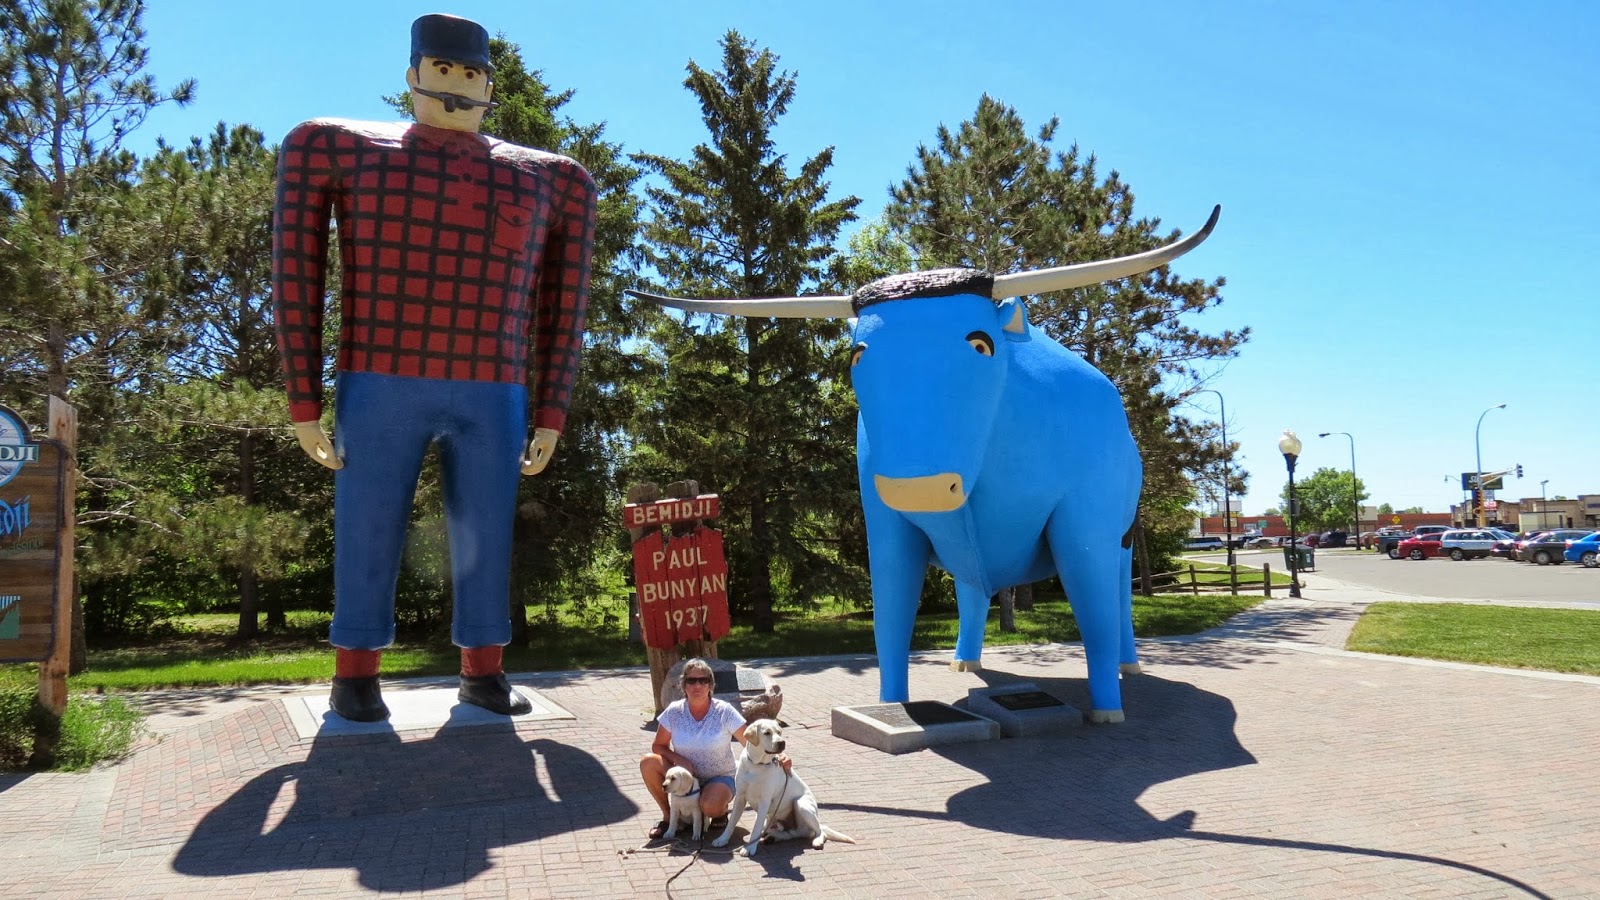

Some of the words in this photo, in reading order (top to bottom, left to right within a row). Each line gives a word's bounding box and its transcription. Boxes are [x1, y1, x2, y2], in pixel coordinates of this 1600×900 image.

[633, 501, 709, 524] BEMIDJI
[653, 547, 707, 570] PAUL
[643, 573, 725, 603] BUNYAN
[665, 606, 708, 630] 1937
